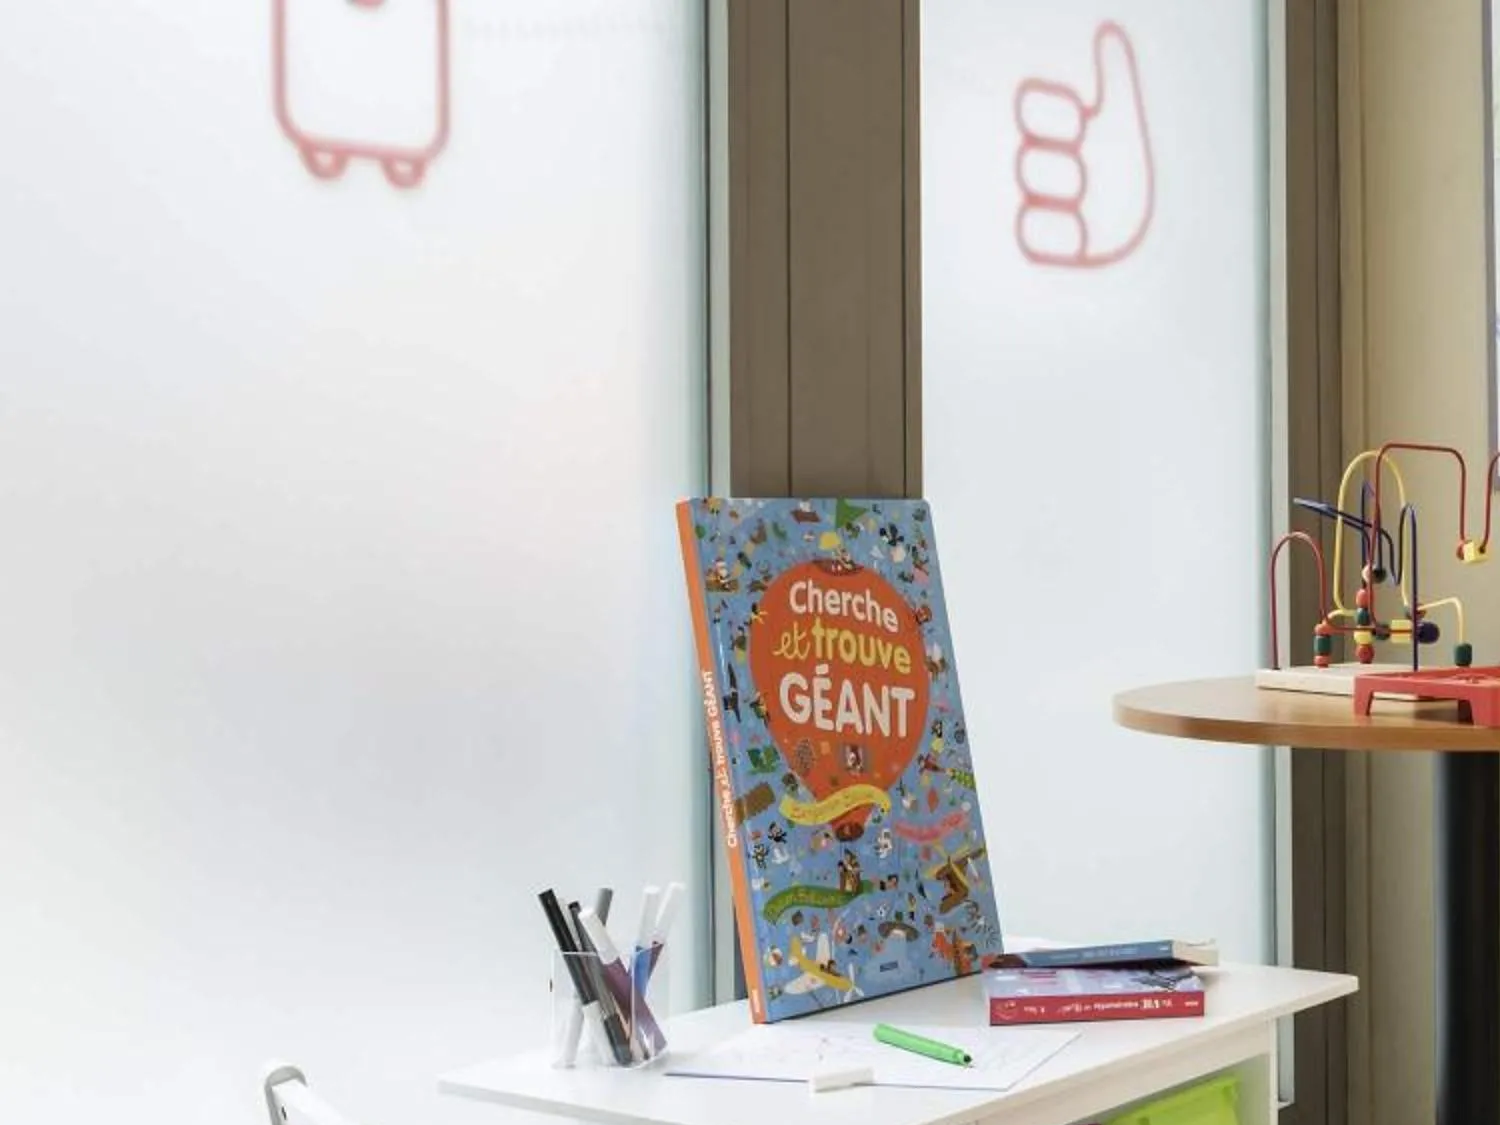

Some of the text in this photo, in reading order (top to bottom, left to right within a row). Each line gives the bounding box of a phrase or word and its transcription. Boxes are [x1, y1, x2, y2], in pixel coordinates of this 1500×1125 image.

[789, 579, 899, 633] Cherche
[772, 616, 911, 674] et trouve
[779, 663, 916, 738] GÉANT
